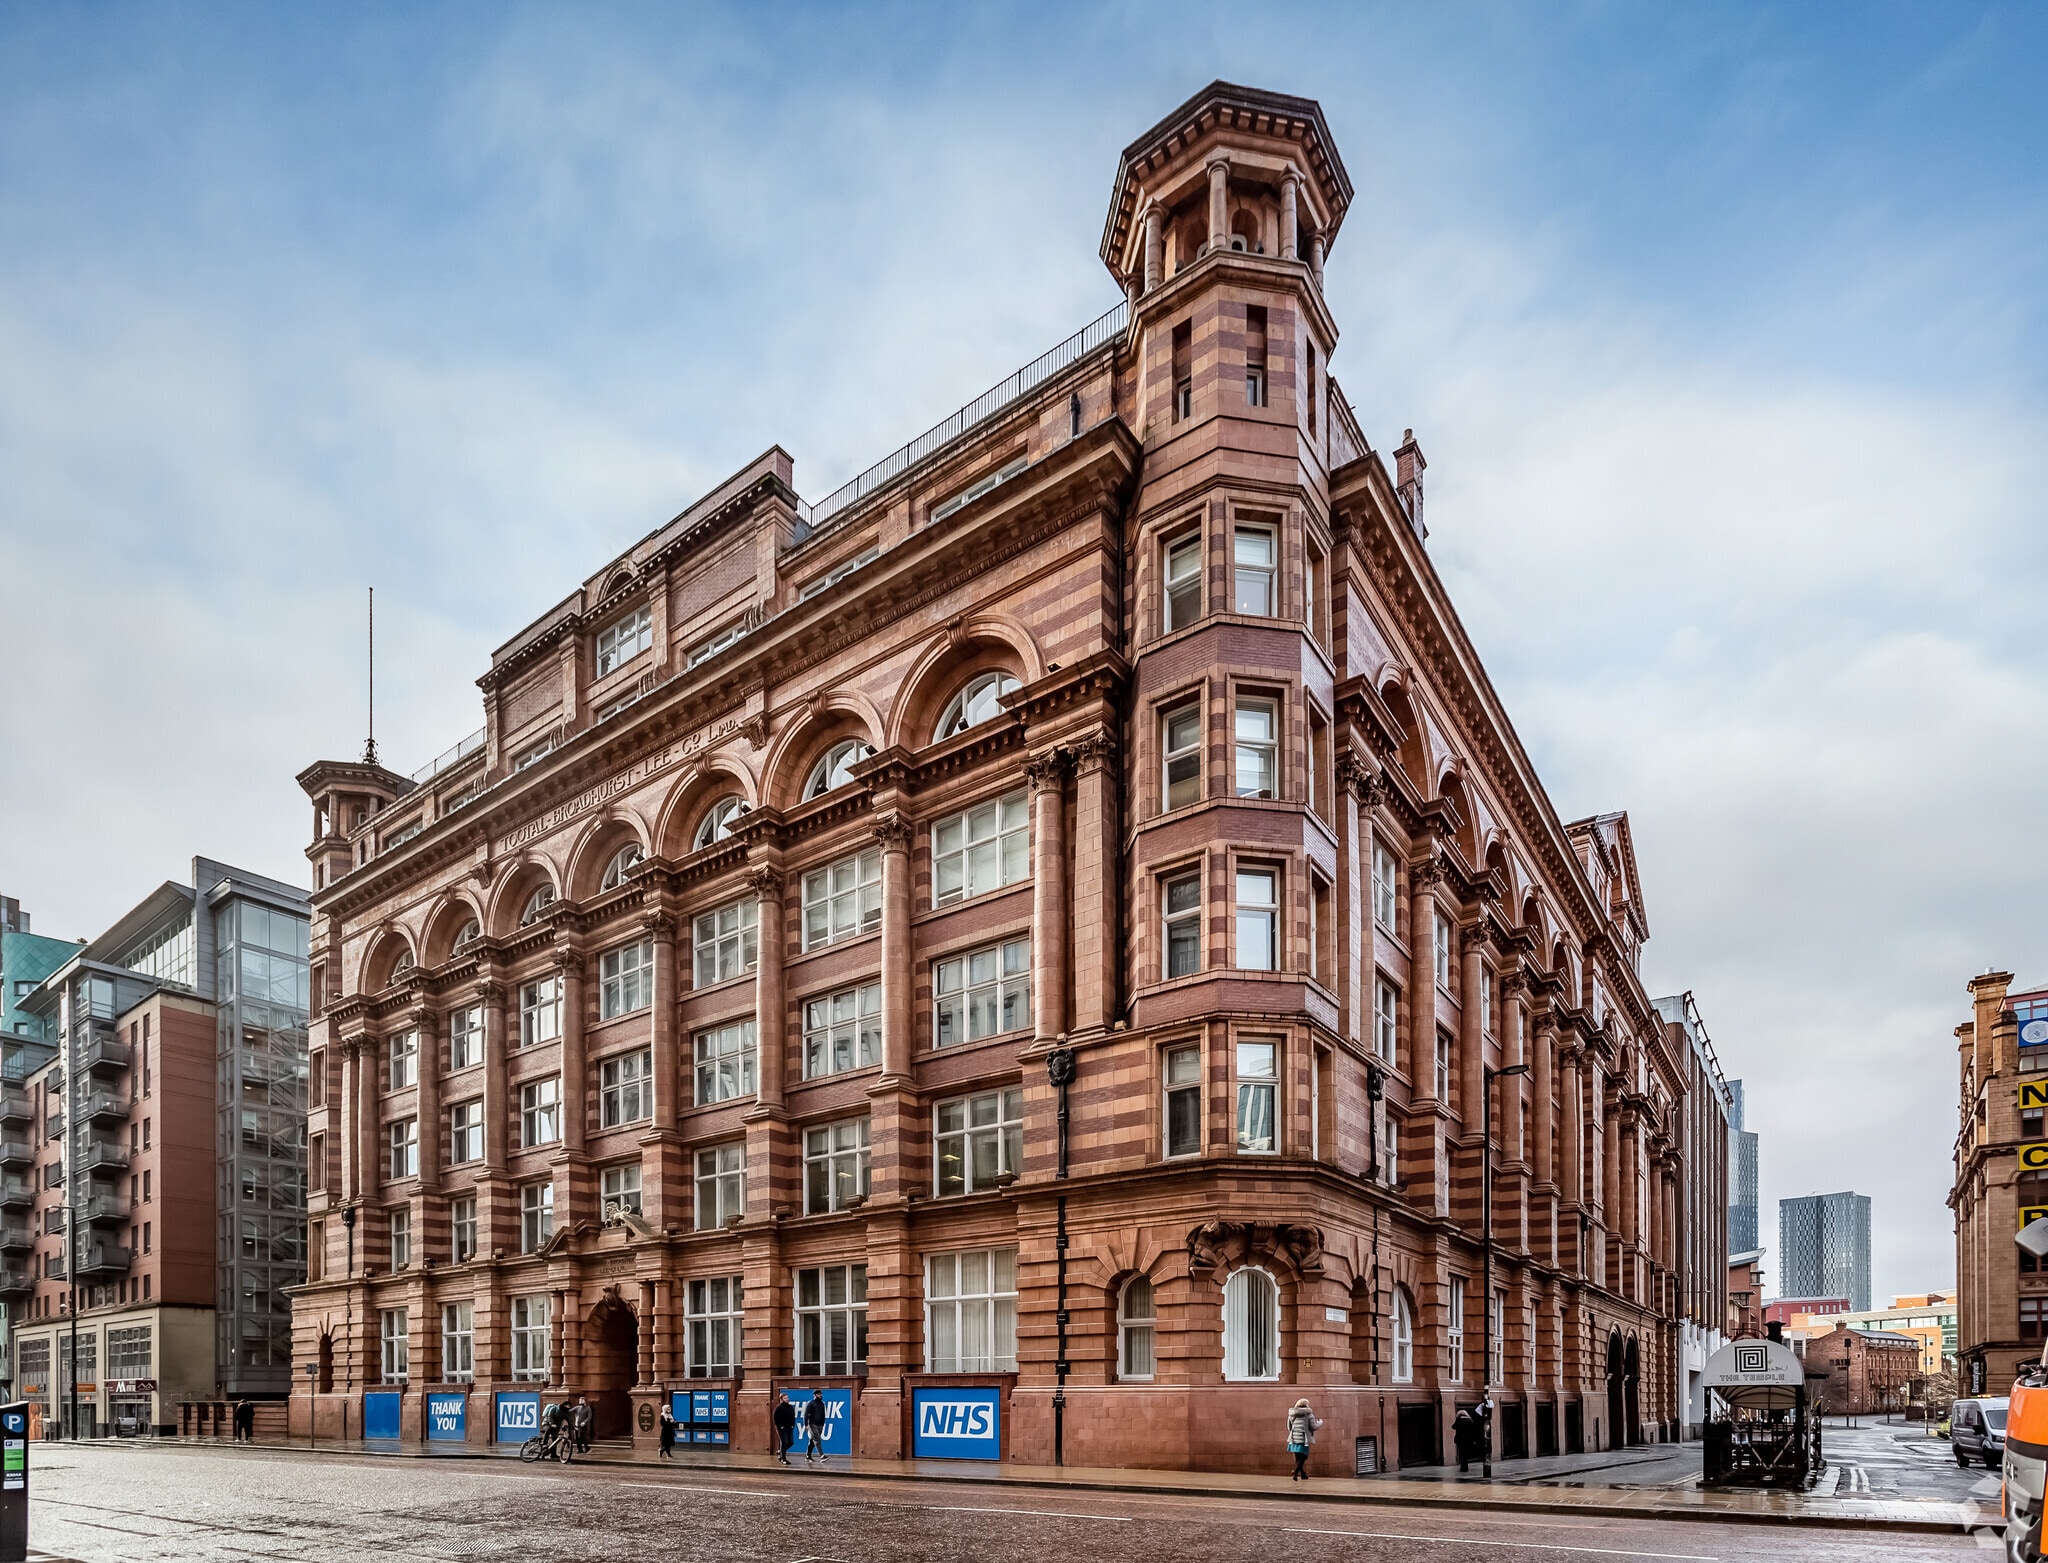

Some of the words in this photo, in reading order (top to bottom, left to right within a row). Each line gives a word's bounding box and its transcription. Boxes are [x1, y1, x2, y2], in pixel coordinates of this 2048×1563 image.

[501, 818, 548, 851] TOOTAL
[552, 769, 634, 826] BROADHURST
[644, 748, 672, 776] LEE
[1743, 1373, 1785, 1381] TEMPLE
[431, 1402, 462, 1415] THANK
[501, 1404, 535, 1426] NHS
[788, 1401, 844, 1419] HNK
[8, 1415, 21, 1430] P
[436, 1418, 456, 1431] YOU
[923, 1405, 990, 1435] NHS
[796, 1423, 833, 1441] YU
